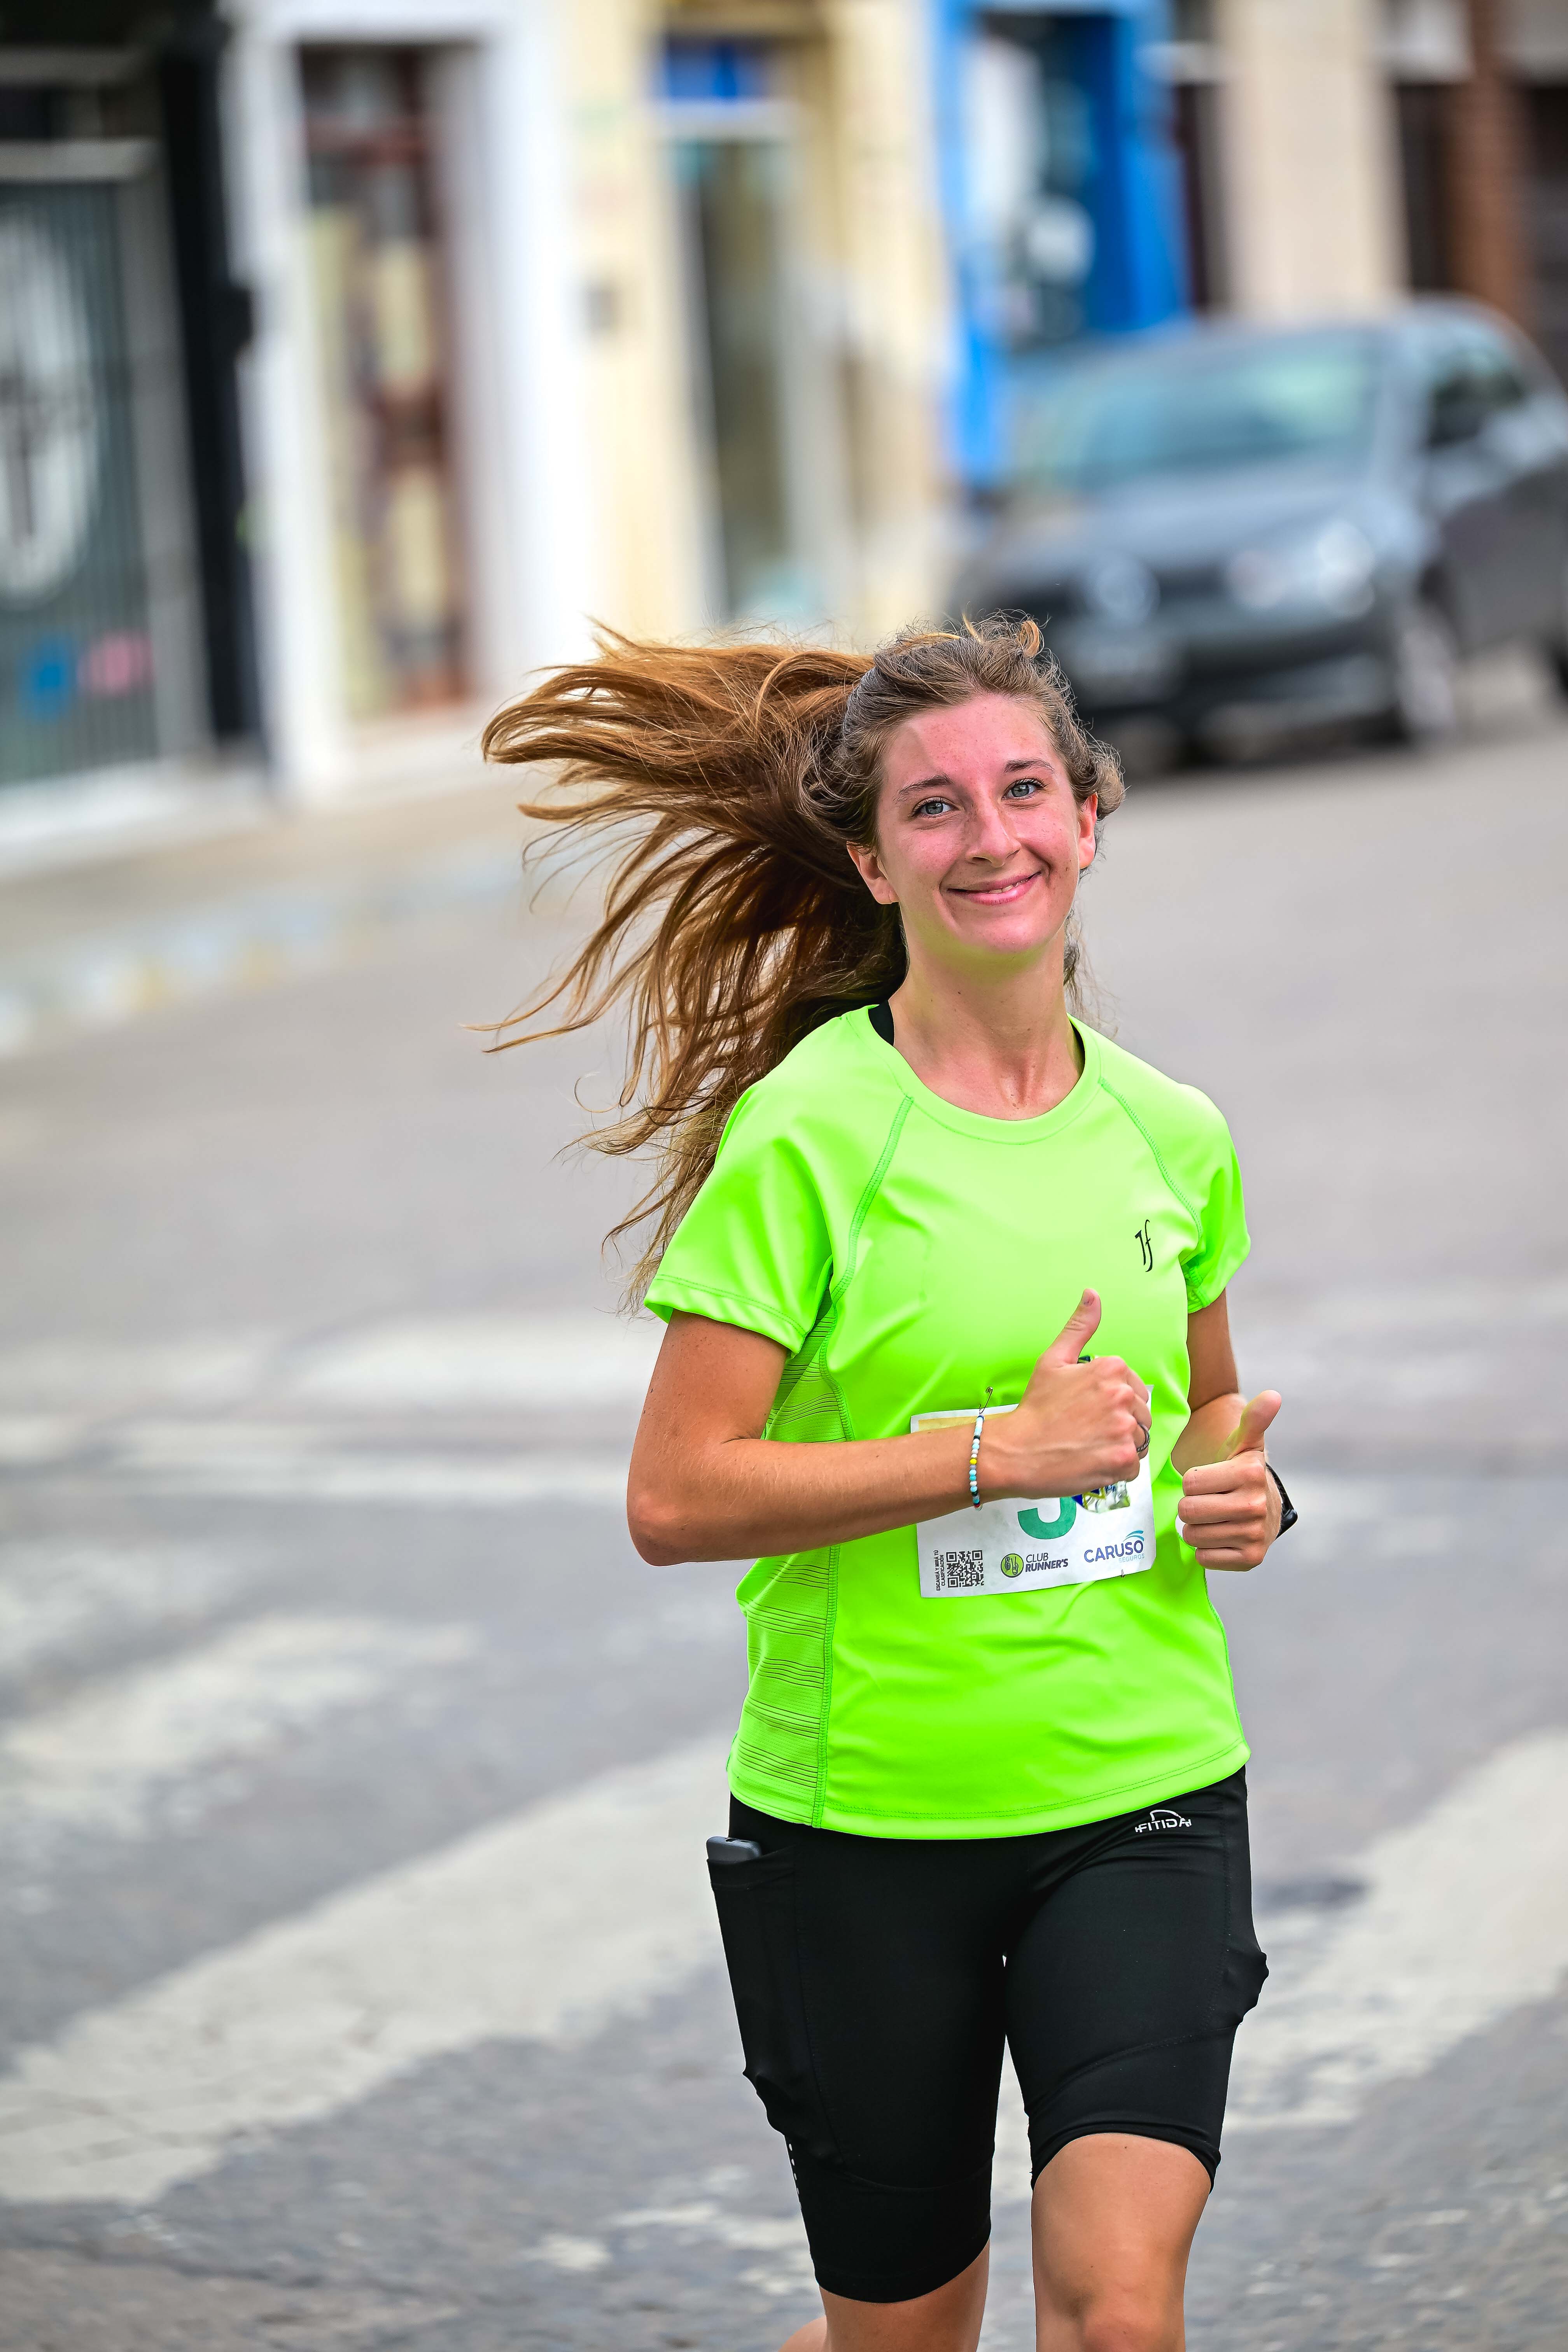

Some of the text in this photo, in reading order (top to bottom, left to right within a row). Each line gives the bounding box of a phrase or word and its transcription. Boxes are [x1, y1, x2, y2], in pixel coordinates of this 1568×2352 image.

[1026, 1552, 1048, 1563] CLUB
[1084, 1540, 1143, 1563] CARUSO
[1118, 1553, 1145, 1563] SEGUROS
[1025, 1558, 1068, 1572] RUNNER'S
